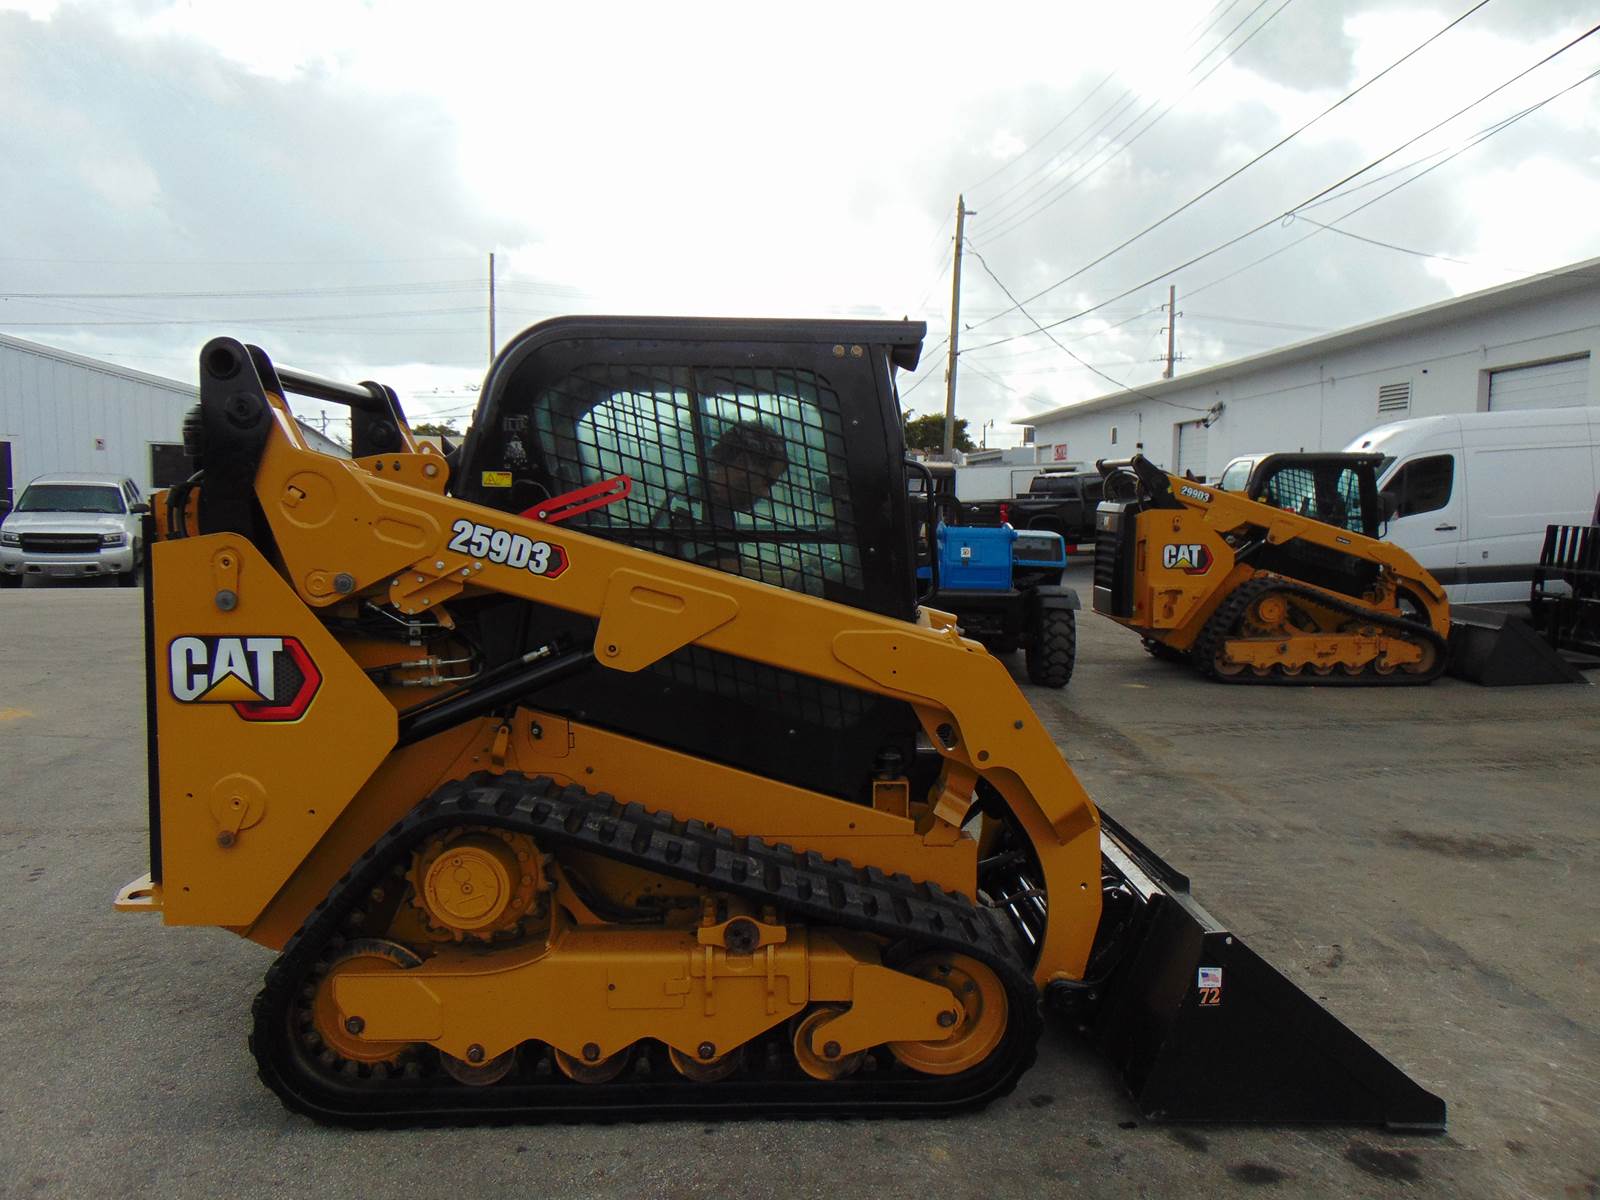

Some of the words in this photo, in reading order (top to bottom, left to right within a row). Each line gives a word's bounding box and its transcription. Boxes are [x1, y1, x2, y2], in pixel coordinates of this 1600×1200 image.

[448, 519, 551, 574] 259D3
[1163, 544, 1201, 568] CAT
[170, 636, 283, 701] CAT
[1199, 987, 1220, 1004] 72
